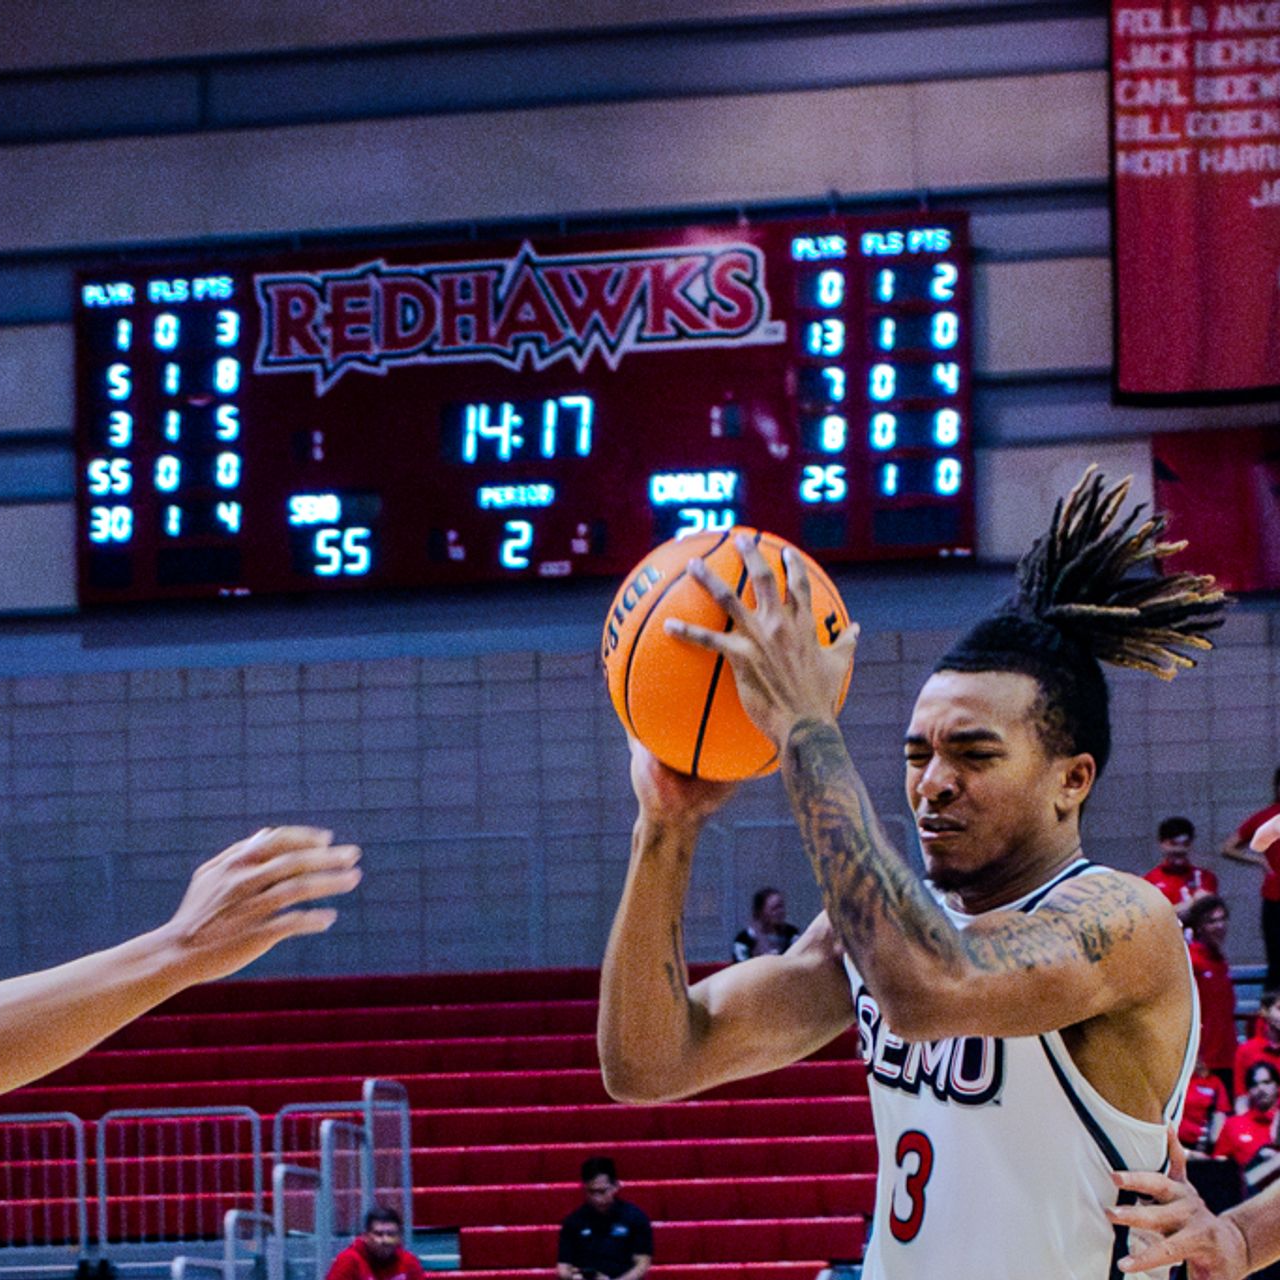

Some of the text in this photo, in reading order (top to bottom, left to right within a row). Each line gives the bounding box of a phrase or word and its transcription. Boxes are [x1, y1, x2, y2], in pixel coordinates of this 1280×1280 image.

[1119, 39, 1190, 72] JACK
[148, 279, 190, 303] FLS
[265, 250, 766, 366] REDHAWKS
[817, 262, 958, 309] 0 1 2
[116, 309, 240, 352] 1 0 3
[806, 310, 958, 357] 13 1 0
[107, 357, 240, 400] 5 1 8
[821, 361, 960, 403] 7 0 4
[109, 404, 240, 448] 3 1 5
[461, 394, 594, 464] 14:17
[820, 408, 961, 454] 8 0 8
[87, 451, 240, 496] 55 0 0
[799, 457, 961, 504] 25 1 0
[477, 484, 554, 510] PERIOD
[89, 501, 241, 543] 30 1 4
[499, 520, 532, 569] 2
[313, 527, 371, 577] 55
[856, 988, 1006, 1106] SEMO
[888, 1128, 935, 1245] 3
